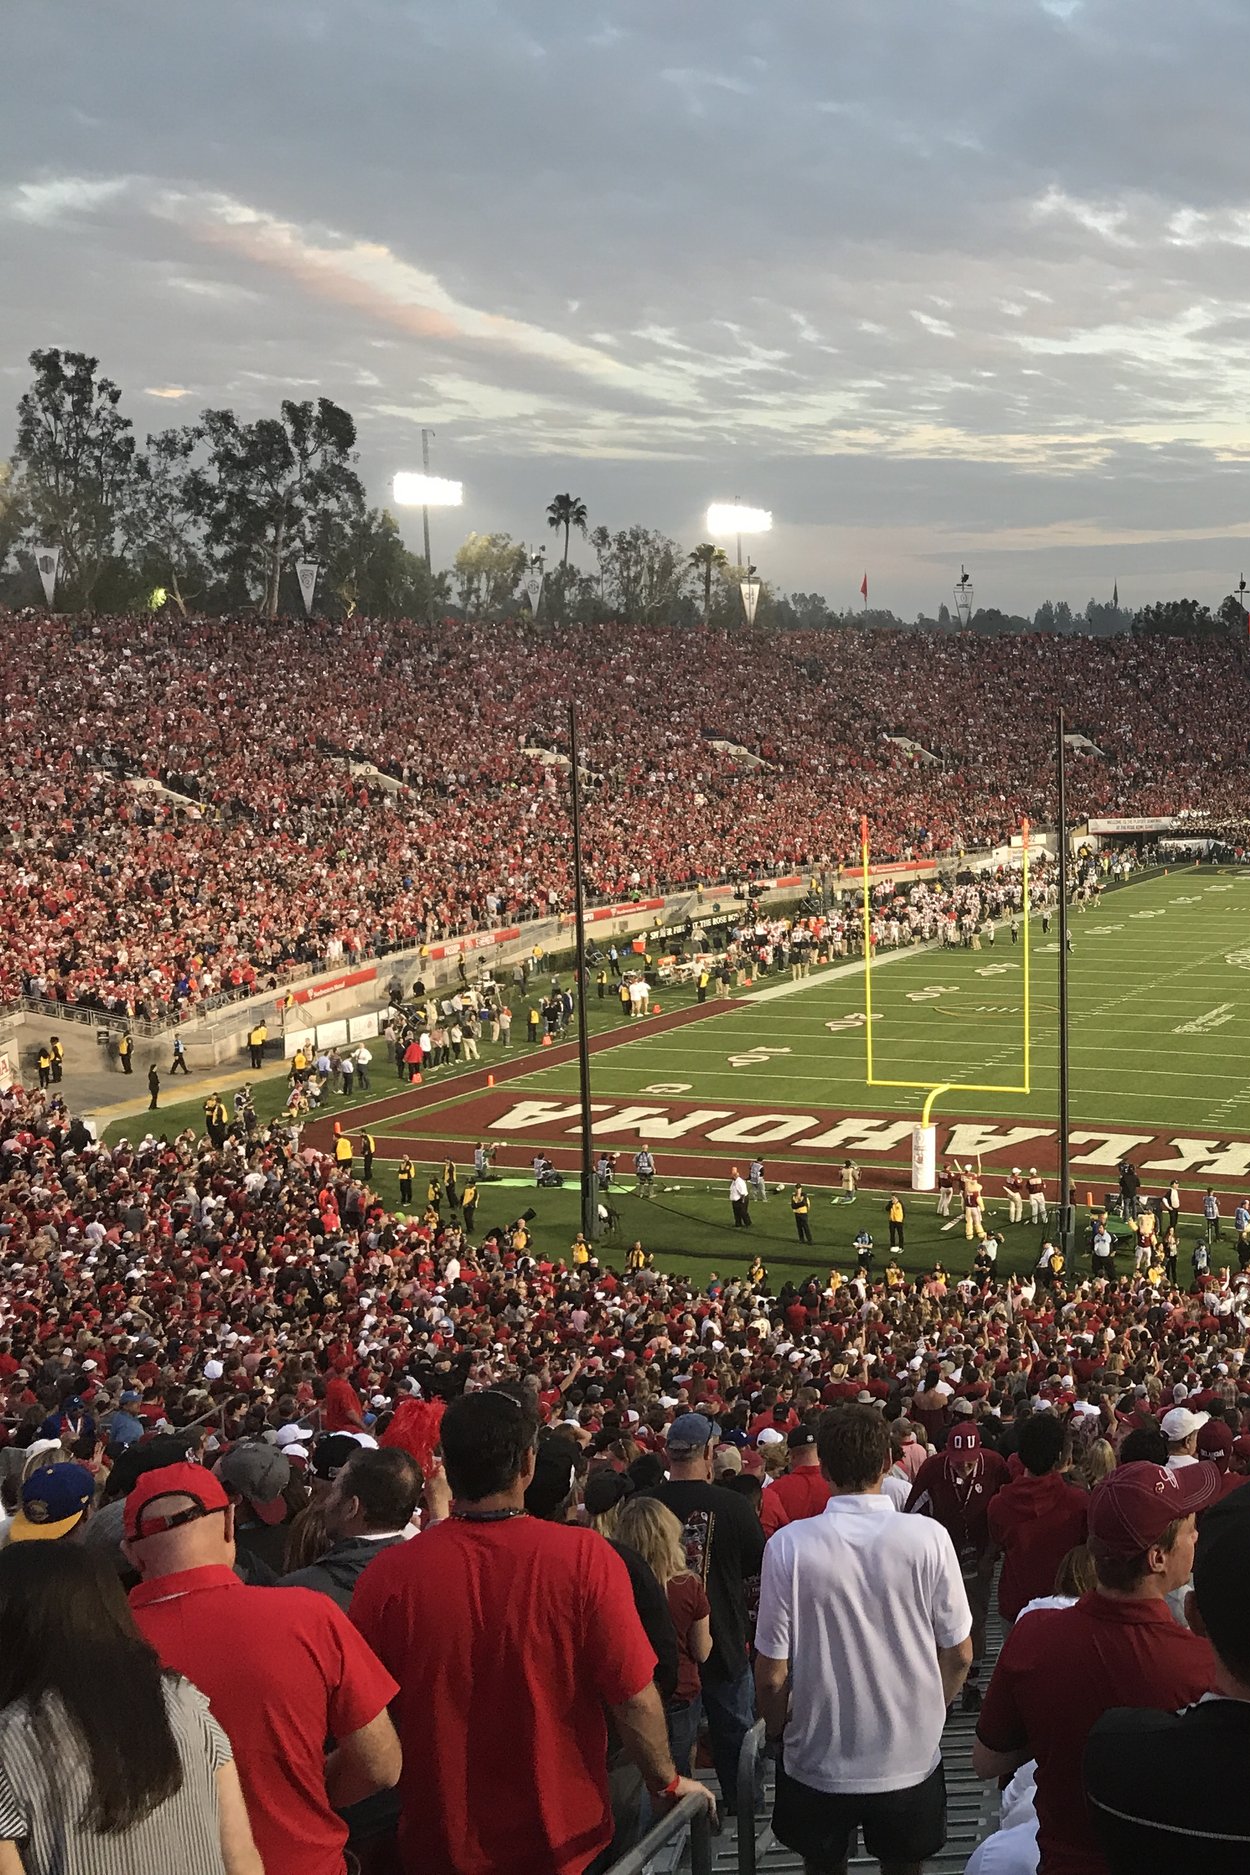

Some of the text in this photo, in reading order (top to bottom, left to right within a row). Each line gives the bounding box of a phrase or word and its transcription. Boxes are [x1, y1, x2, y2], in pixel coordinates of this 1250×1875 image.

[699, 918, 712, 928] THE
[712, 915, 728, 926] ROSE
[727, 1046, 793, 1063] 10
